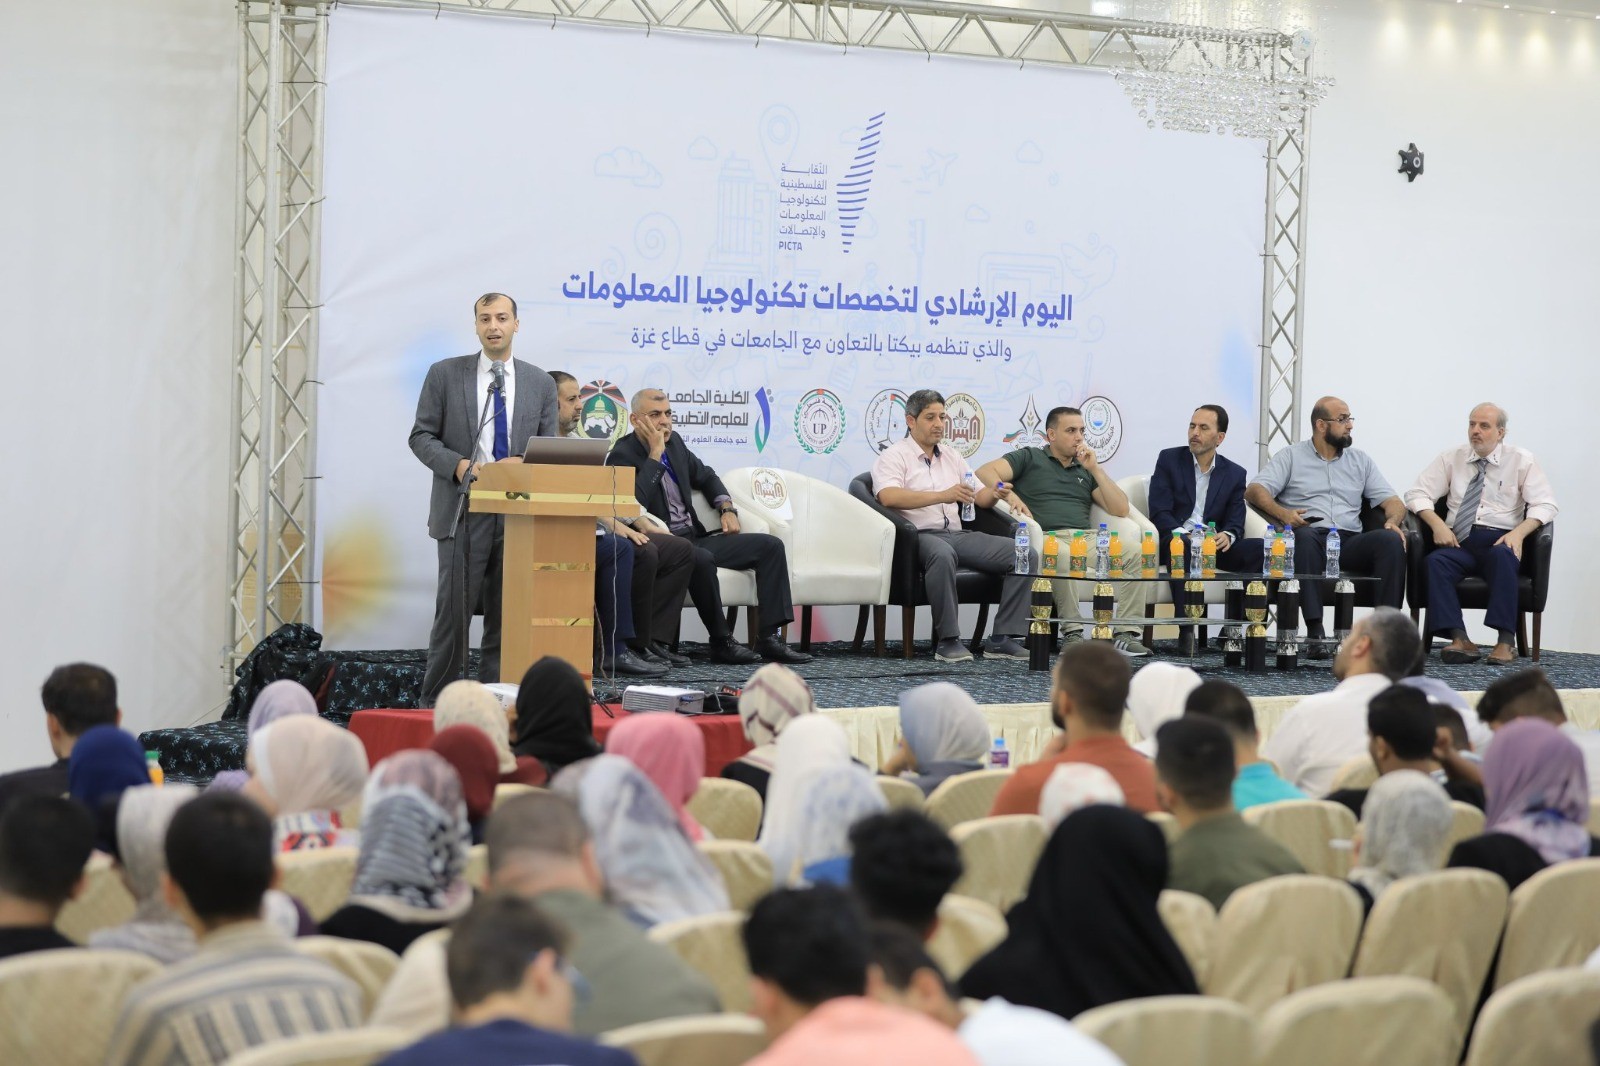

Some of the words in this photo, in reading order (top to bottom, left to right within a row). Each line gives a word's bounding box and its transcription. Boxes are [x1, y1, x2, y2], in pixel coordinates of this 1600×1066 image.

[780, 178, 827, 191] الفلسطينية
[779, 193, 827, 207] لتكنولوجيا
[779, 208, 826, 222] المعلومات
[779, 241, 803, 251] PICTA
[562, 271, 688, 309] المعلومات
[697, 276, 808, 314] تكنولوجيا
[813, 282, 918, 313] لتخصصات
[925, 286, 1017, 327] الإرشادي
[1022, 294, 1073, 328] اليوم
[631, 327, 656, 348] غزة
[661, 326, 700, 350] قطاع
[705, 328, 726, 356] في
[731, 329, 798, 352] الجامعات
[802, 337, 821, 355] مع
[826, 333, 883, 357] بالتعاون
[888, 334, 921, 358] بيكتا
[925, 337, 969, 356] تنظمه
[972, 339, 1012, 362] والذي
[667, 389, 712, 406] الجامع
[714, 390, 749, 406] الكلية
[672, 411, 709, 427] التطبيق
[711, 411, 749, 428] للعلوم
[813, 423, 827, 434] UP
[714, 436, 734, 444] جامعة
